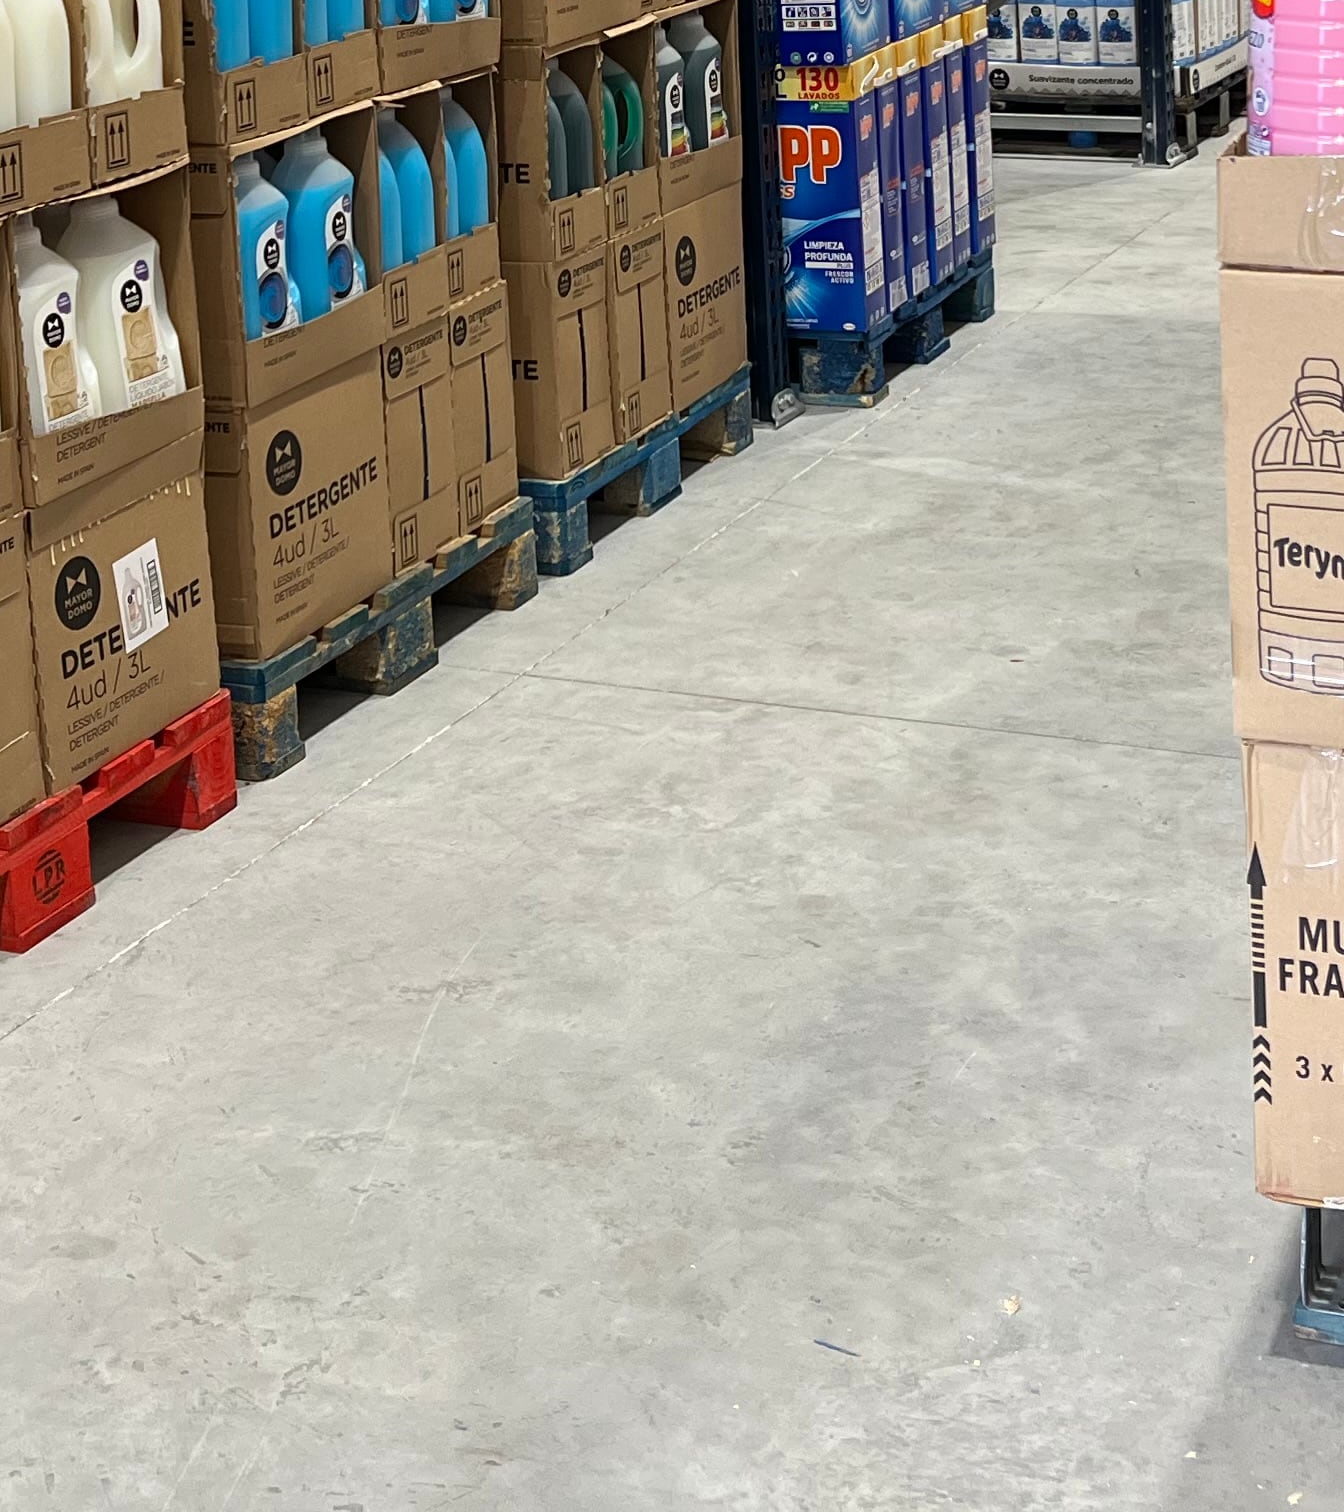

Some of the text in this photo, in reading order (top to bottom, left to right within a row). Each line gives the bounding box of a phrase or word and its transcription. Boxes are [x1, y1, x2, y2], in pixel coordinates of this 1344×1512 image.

[796, 67, 838, 92] 130
[1029, 74, 1134, 86] Suavizante concentrado
[798, 92, 840, 100] LAVADOS
[804, 241, 844, 250] LIMPIEZA
[805, 252, 853, 261] PROFUNDA
[678, 266, 741, 319] DETERGENTE
[269, 456, 378, 539] DETERGENTE
[273, 531, 305, 568] 4ud
[321, 516, 340, 543] 3L
[64, 588, 93, 609] MAYOR
[68, 601, 93, 620] DOMO
[61, 578, 202, 680] DETENTE
[66, 669, 106, 711] 4ud
[129, 649, 151, 680] 3L
